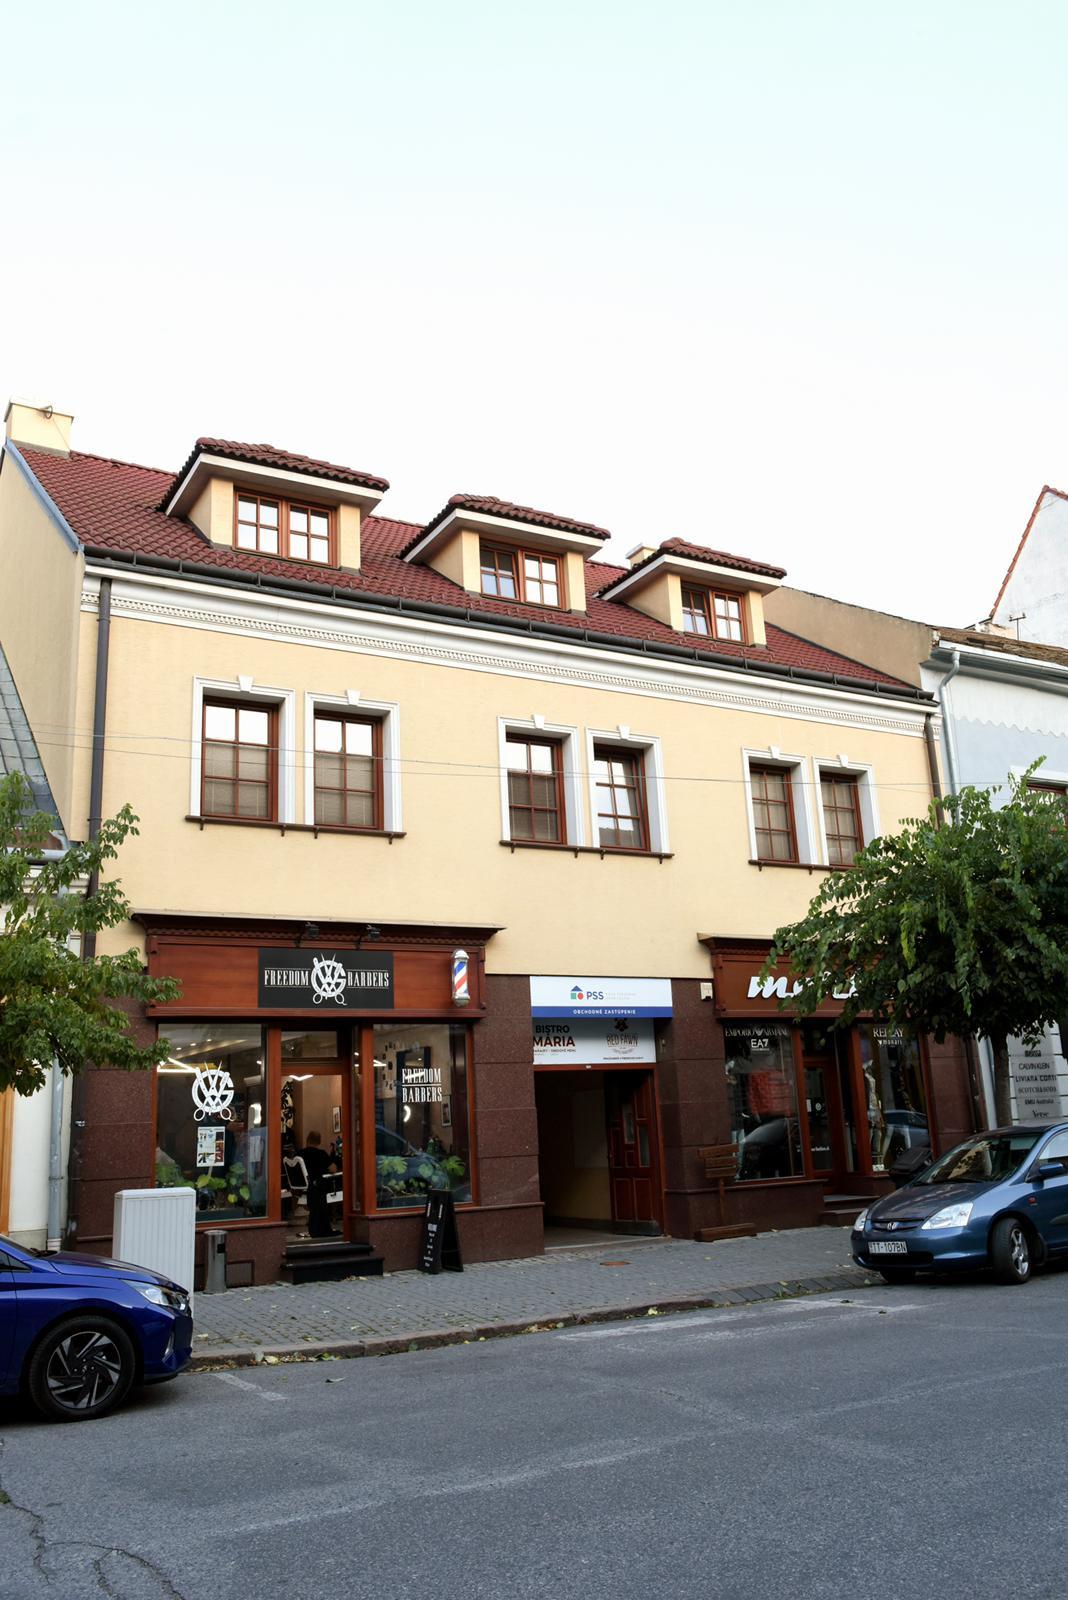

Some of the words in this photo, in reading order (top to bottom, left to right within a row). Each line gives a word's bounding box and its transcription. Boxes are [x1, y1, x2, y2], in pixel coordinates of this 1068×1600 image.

[264, 969, 309, 986] FREEDOM
[347, 971, 390, 987] BARBERS
[586, 991, 604, 1000] PSS
[535, 1024, 570, 1034] BISTRO
[873, 1027, 904, 1038] REAY
[751, 1038, 769, 1048] EA7
[402, 1068, 441, 1084] FREEDOM
[402, 1087, 443, 1103] BARBERS
